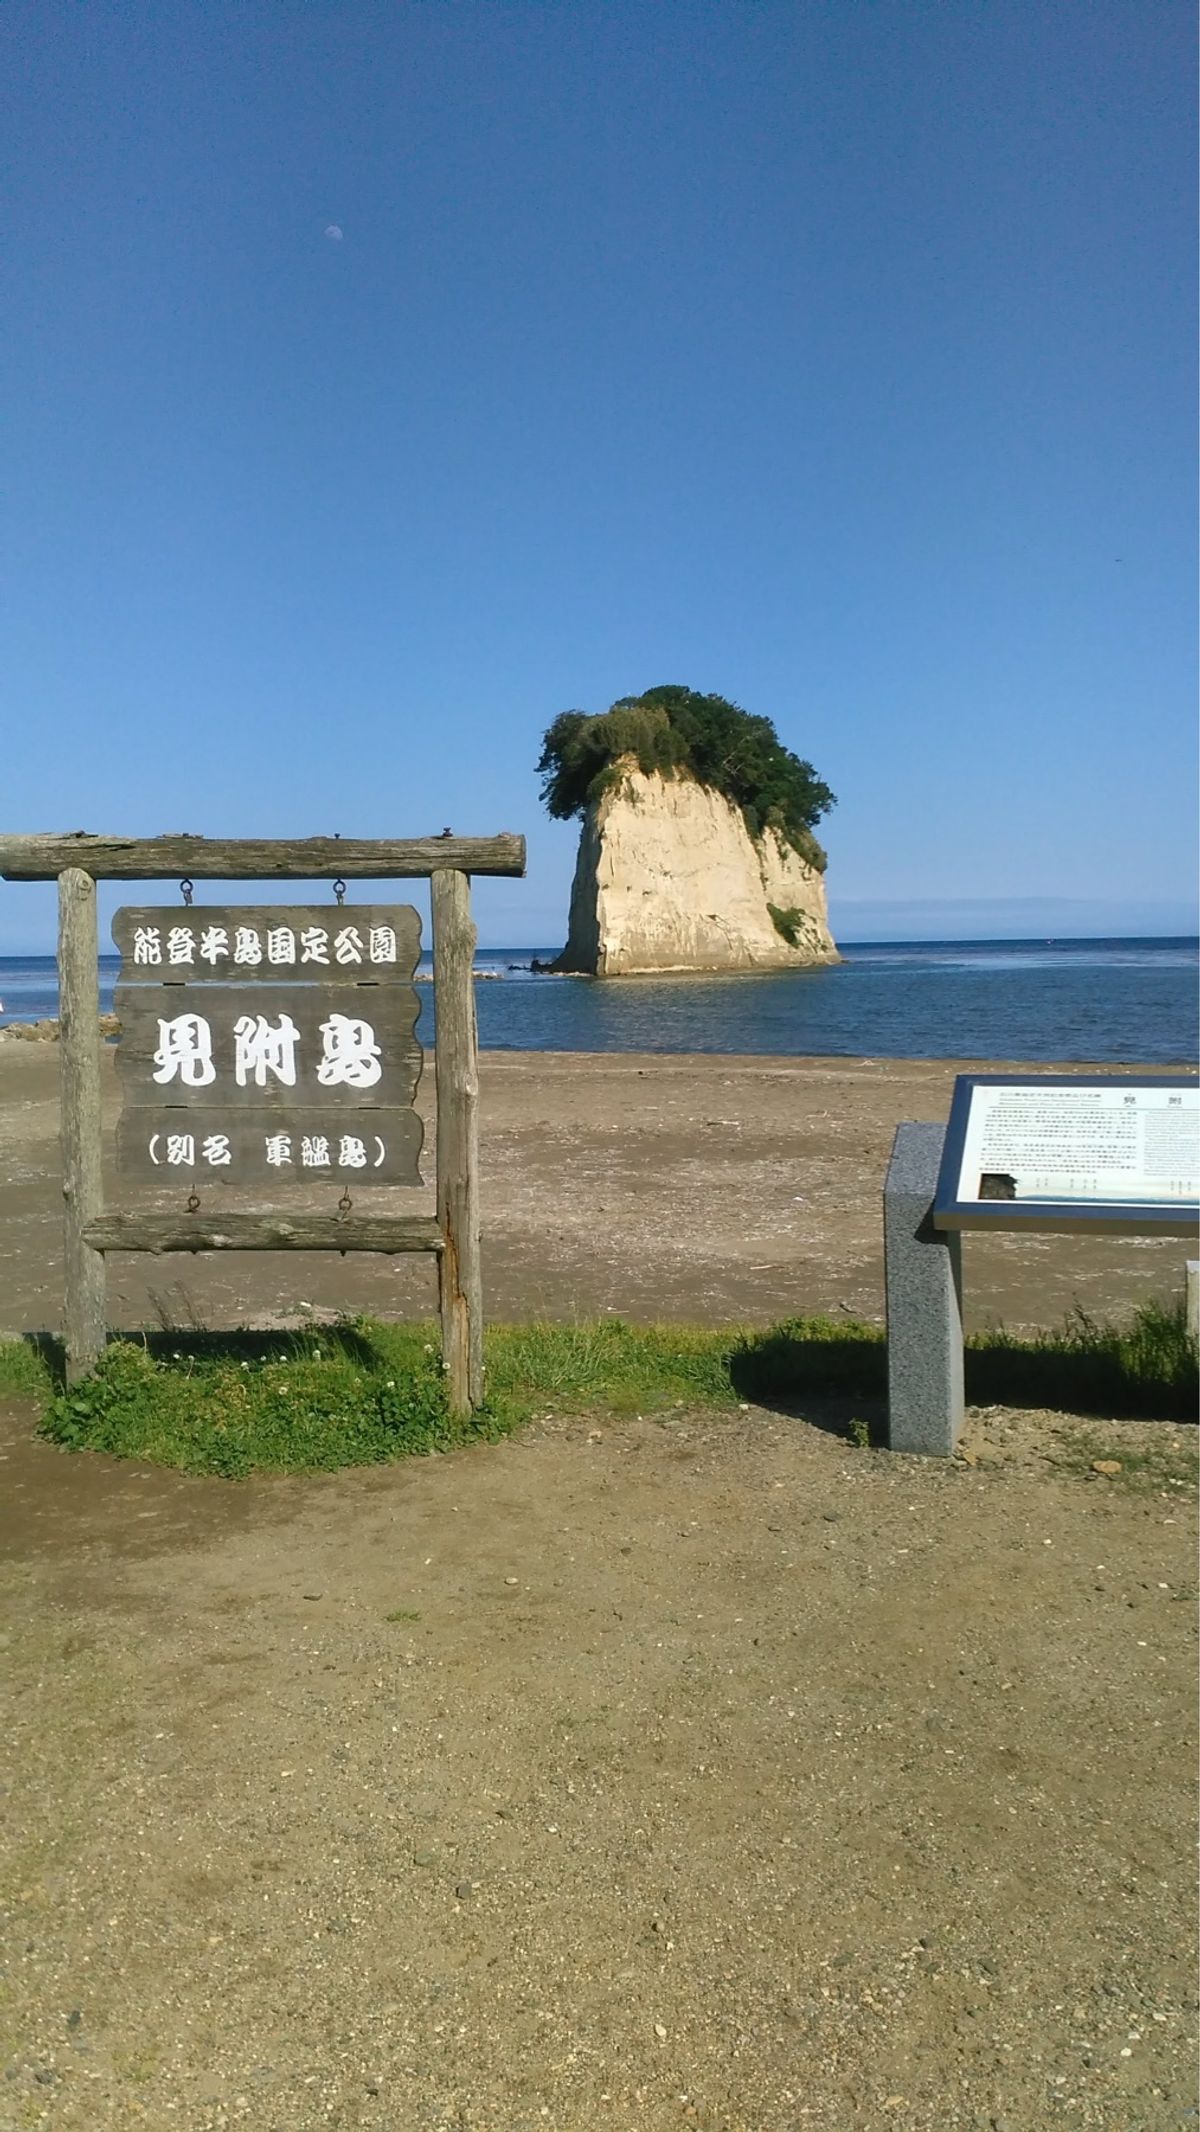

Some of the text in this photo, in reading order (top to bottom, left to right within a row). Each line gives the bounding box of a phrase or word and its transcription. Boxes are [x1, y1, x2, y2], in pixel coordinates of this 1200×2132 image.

[133, 926, 397, 965] 能登半島国定公園
[152, 1013, 382, 1088] 見附島
